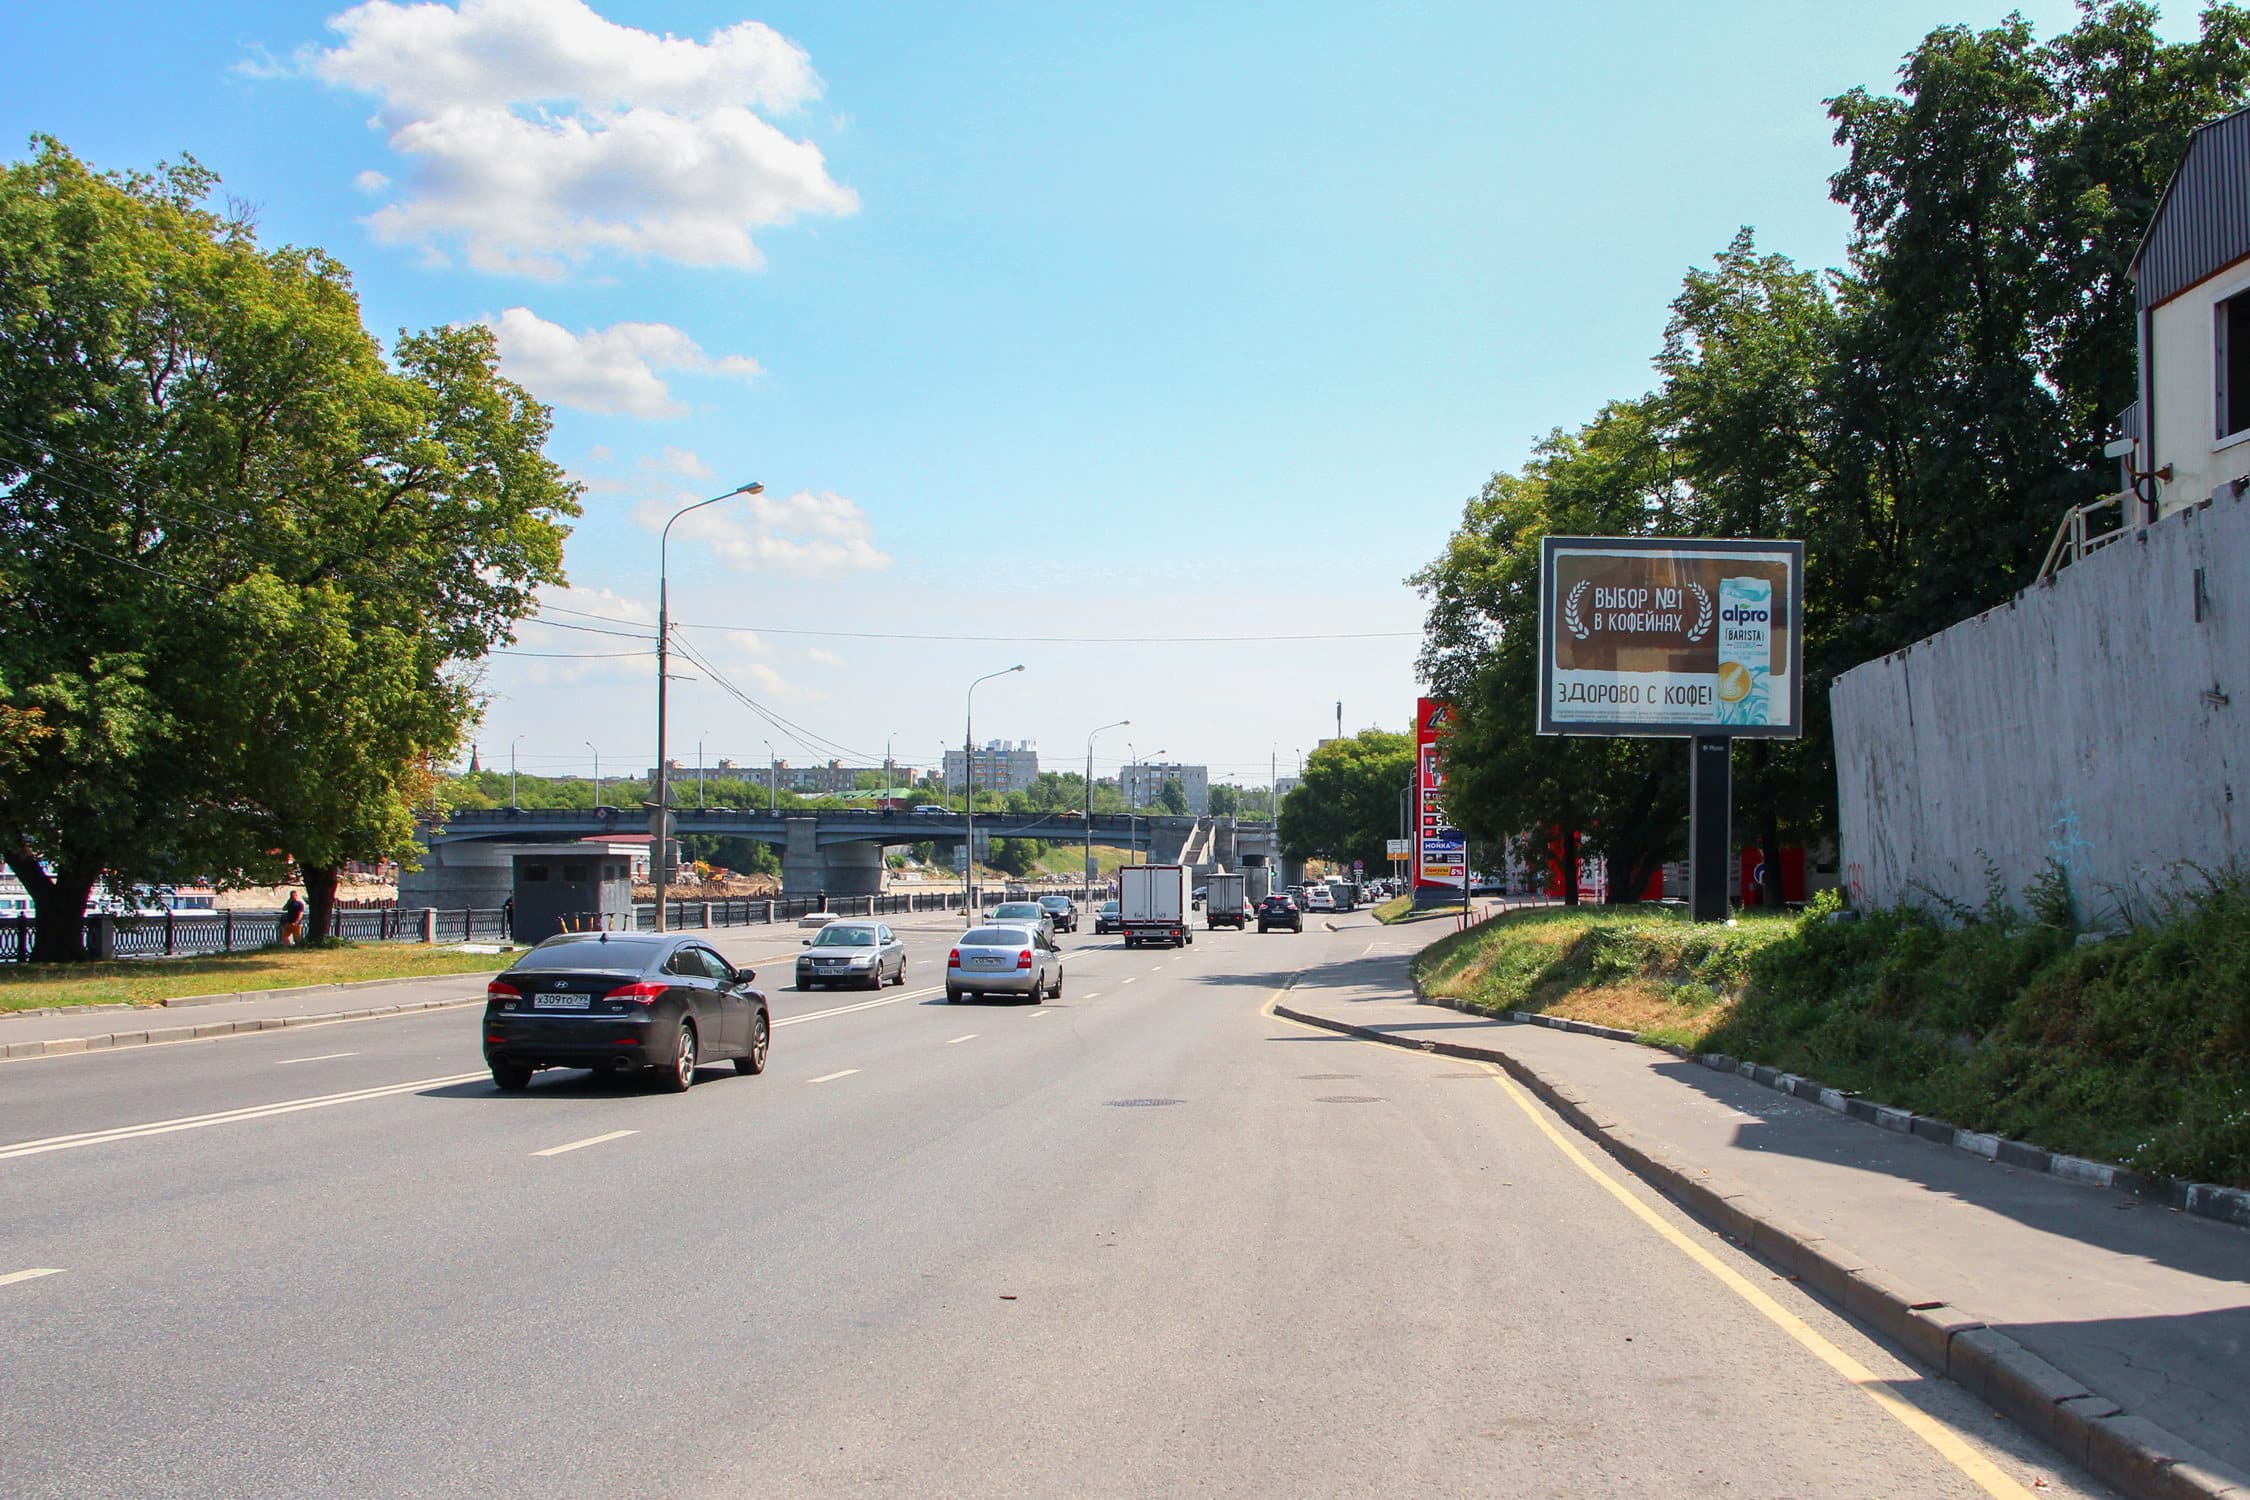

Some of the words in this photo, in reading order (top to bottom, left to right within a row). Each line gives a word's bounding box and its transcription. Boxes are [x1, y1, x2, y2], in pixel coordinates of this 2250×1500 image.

[1595, 587, 1648, 609] ВЫБОР
[1655, 587, 1683, 609] №1
[1594, 612, 1602, 631] В
[1608, 609, 1683, 633] КОФЕЙНЯХ
[1722, 604, 1769, 626] alpro
[1728, 630, 1761, 641] BARISTA
[1558, 682, 1639, 704] ЗДОРОВО
[1647, 685, 1657, 704] С
[1664, 684, 1712, 707] КОФЕ!
